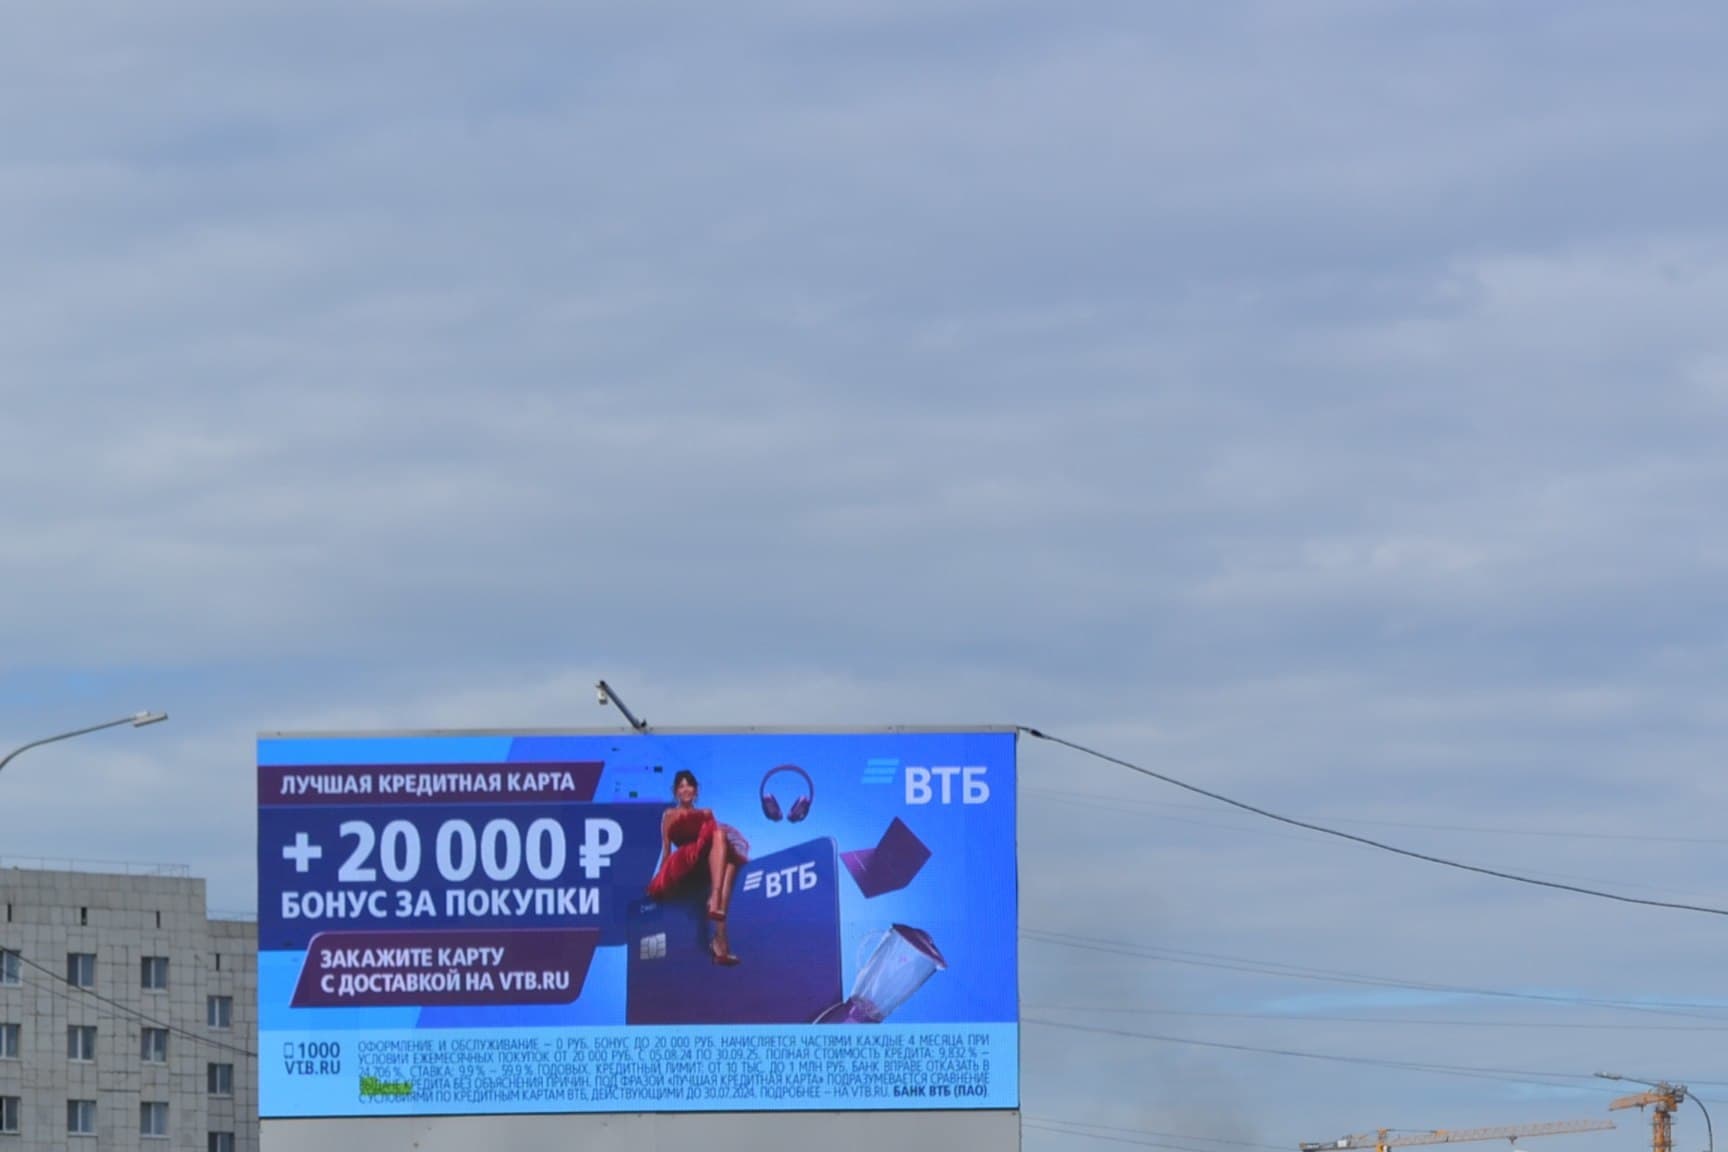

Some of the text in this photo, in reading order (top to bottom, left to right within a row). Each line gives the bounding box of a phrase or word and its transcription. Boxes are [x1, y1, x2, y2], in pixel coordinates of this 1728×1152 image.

[281, 772, 575, 796] ЛУЧШАЯ КРЕДИТНАЯ КАРТА
[905, 766, 990, 805] ВТБ
[338, 820, 422, 882] 20
[435, 818, 566, 881] 000
[765, 861, 818, 898] ВТБ
[282, 888, 600, 919] БОНУС ЗА ПОКУПКИ
[320, 947, 504, 968] ЗАКАЖИТЕ КАРТУ
[321, 968, 569, 996] С ДОСТАВКОЙ НА VTB.RU
[298, 1042, 340, 1058] 1000
[359, 1039, 432, 1052] ОФОРМЛЕНИЕ
[451, 1038, 538, 1051] ОБСЛУЖИВАНИЕ
[594, 1037, 629, 1049] БОНУС
[671, 1037, 690, 1049] 000
[721, 1036, 796, 1048] НАЧИСЛЯЕТСЯ
[801, 1035, 851, 1048] ЧАСТЯМИ
[856, 1035, 903, 1049] КАЖДЫЕ
[920, 1034, 964, 1048] МЕСЯЦА
[968, 1034, 990, 1046] ПРИ
[359, 1052, 409, 1064] УСЛОВИИ
[413, 1051, 494, 1064] ЕЖЕМЕСЯЧНЫХ
[499, 1050, 549, 1063] ПОКУПОК
[588, 1050, 607, 1062] 000
[767, 1048, 810, 1060] ПОЛНАЯ
[814, 1047, 880, 1060] СТОИМОСТЬ
[284, 1060, 341, 1075] VTB.RU
[596, 1062, 661, 1076] КРЕДИТНЫЙ
[799, 1061, 822, 1073] МЛН
[852, 1060, 879, 1073] БАНК
[884, 1060, 922, 1072] ВПРАВЕ
[926, 1060, 979, 1072] ОТКАЗАТЬ
[453, 1077, 471, 1089] БЕЗ
[475, 1076, 543, 1088] ОБЪЯСНЕНИЯ
[595, 1075, 618, 1089] ПОД
[621, 1075, 664, 1087] ФРАЗОЙ
[721, 1074, 782, 1088] КРЕДИТНАЯ
[827, 1072, 928, 1087] ПОДРАЗУМЕВАЕТСЯ
[930, 1072, 990, 1084] СРАВНЕНИЕ
[454, 1089, 519, 1103] КРЕДИТНЫМ
[522, 1089, 565, 1101] КАРТАМ
[591, 1087, 684, 1102] ДЕЙСТВУЮЩИМИ
[761, 1086, 821, 1100] ПОДРОБНЕЕ
[893, 1085, 926, 1097] БАНК
[929, 1085, 951, 1097] ВТБ
